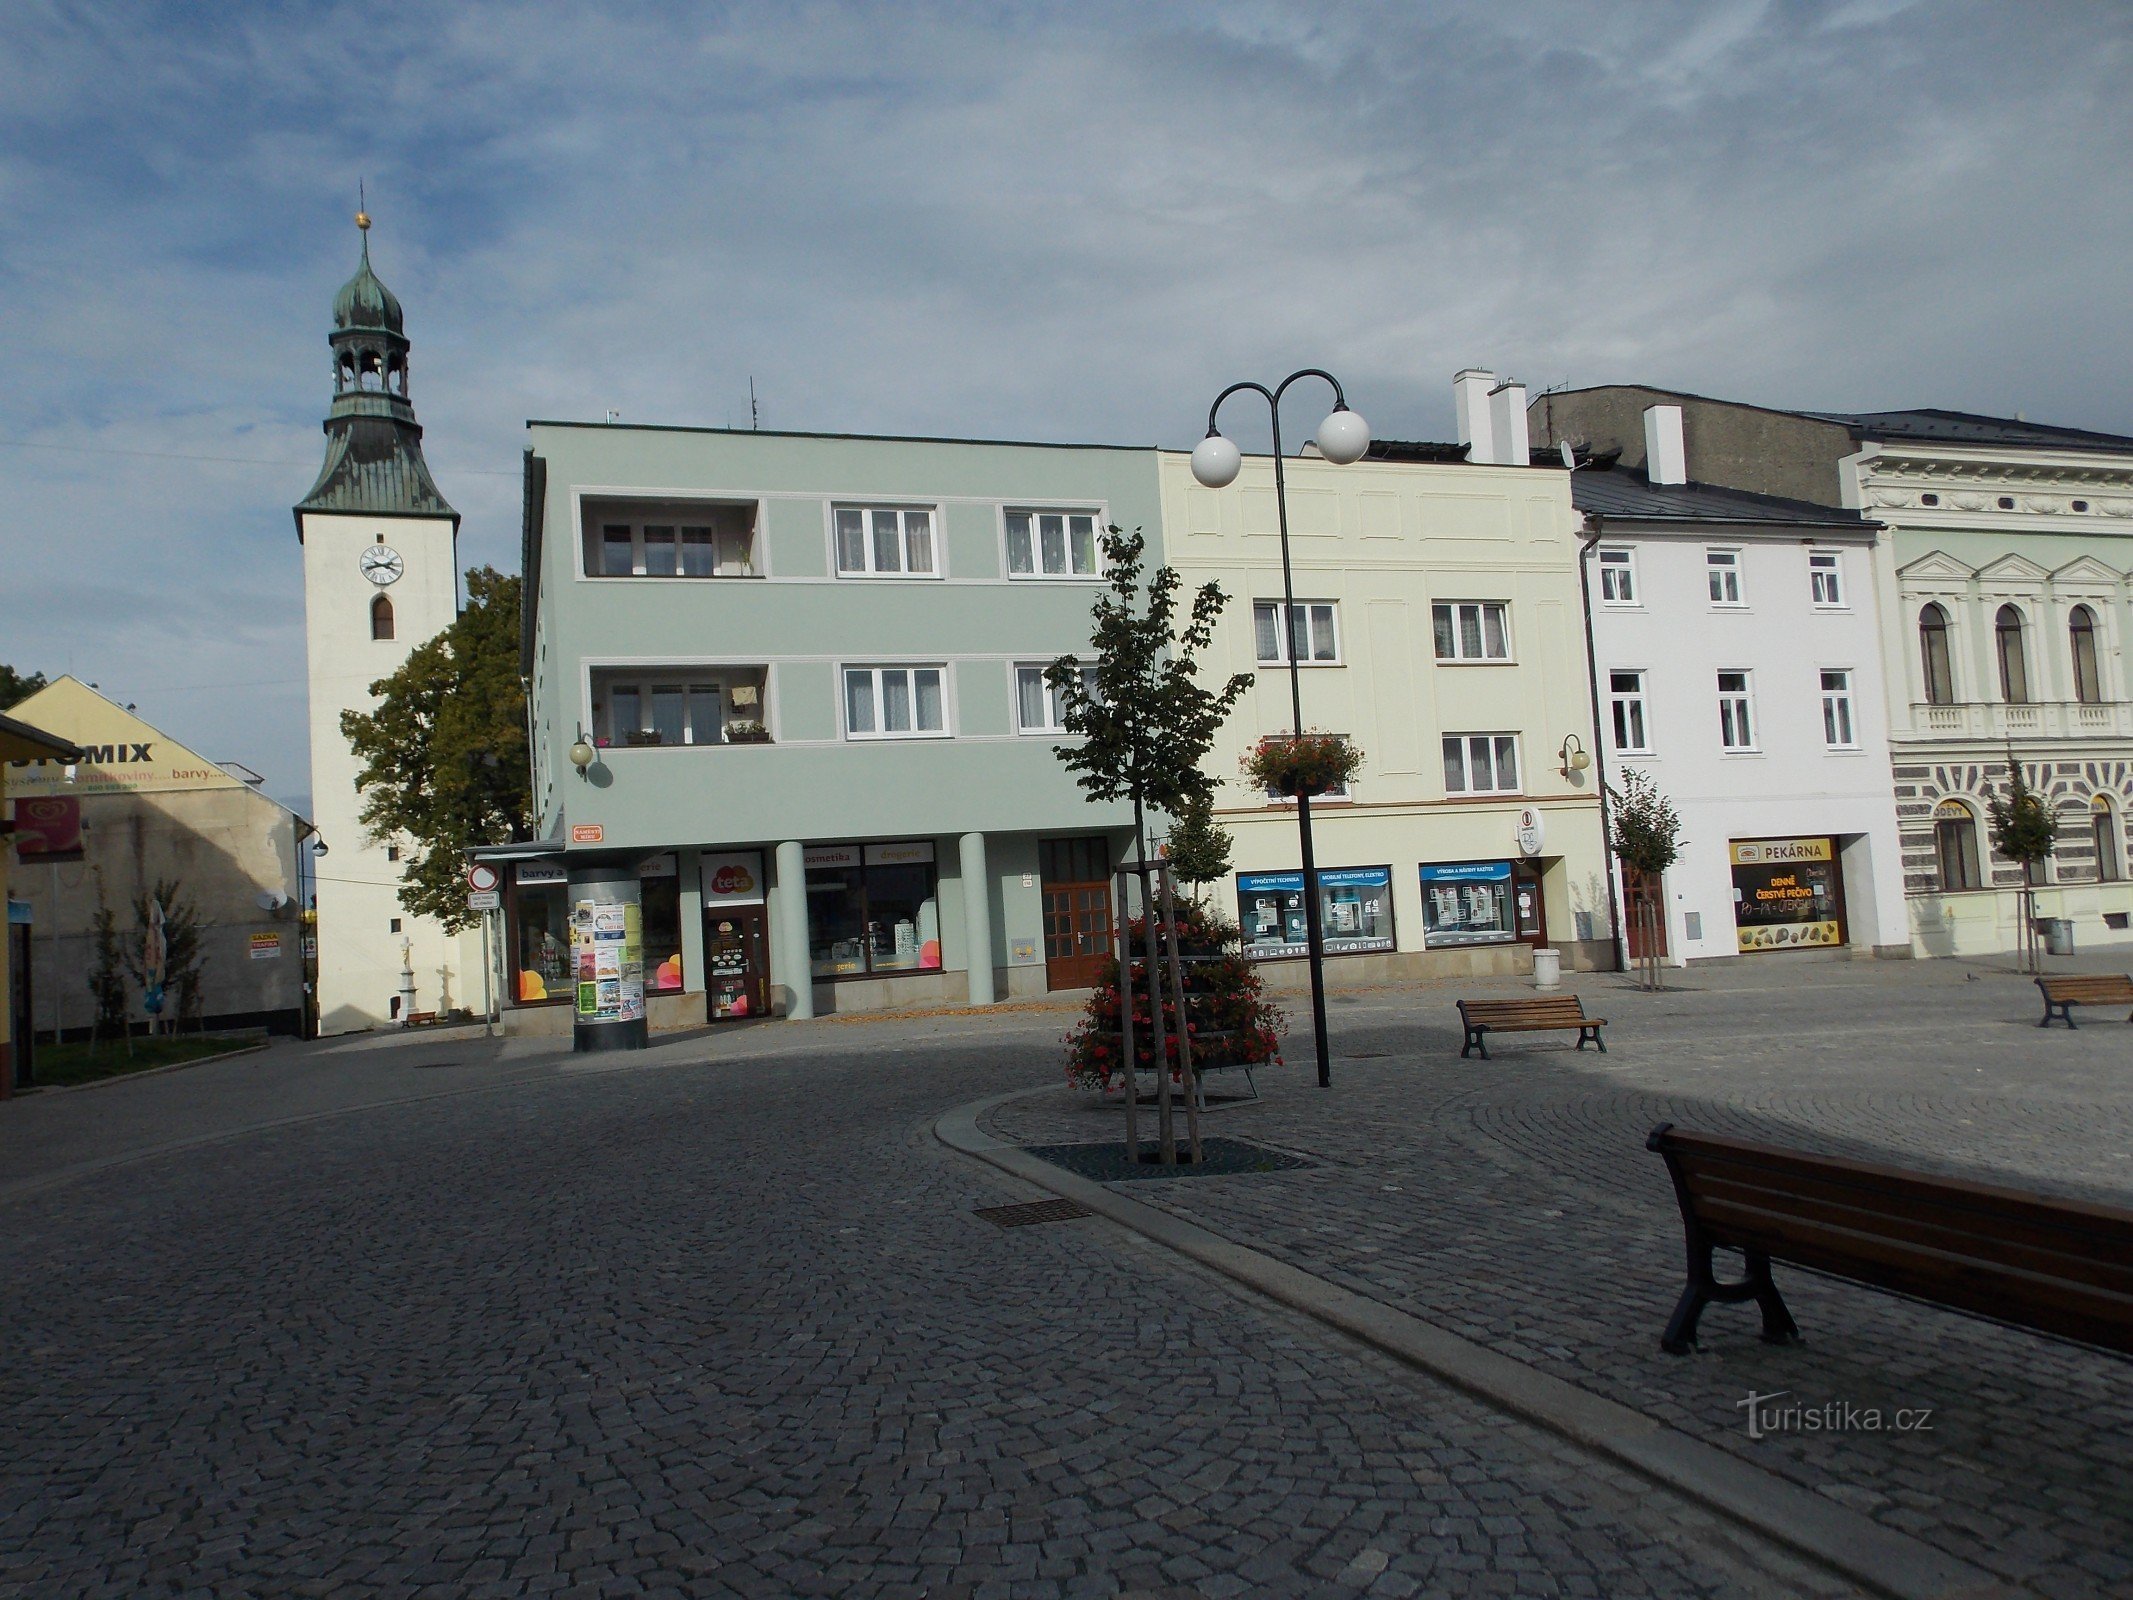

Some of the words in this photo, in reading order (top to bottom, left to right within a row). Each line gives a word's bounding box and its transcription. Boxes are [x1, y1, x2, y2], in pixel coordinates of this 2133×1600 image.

[881, 848, 920, 860] drogerie
[1765, 843, 1822, 858] PEKÁRNA
[805, 852, 850, 863] osmetika
[640, 863, 662, 872] erie
[522, 869, 554, 878] barvy
[717, 876, 748, 888] teta
[1770, 875, 1796, 886] DENNĚ
[1756, 887, 1786, 899] ČERSTVÉ
[1787, 886, 1812, 897] PEČIVO
